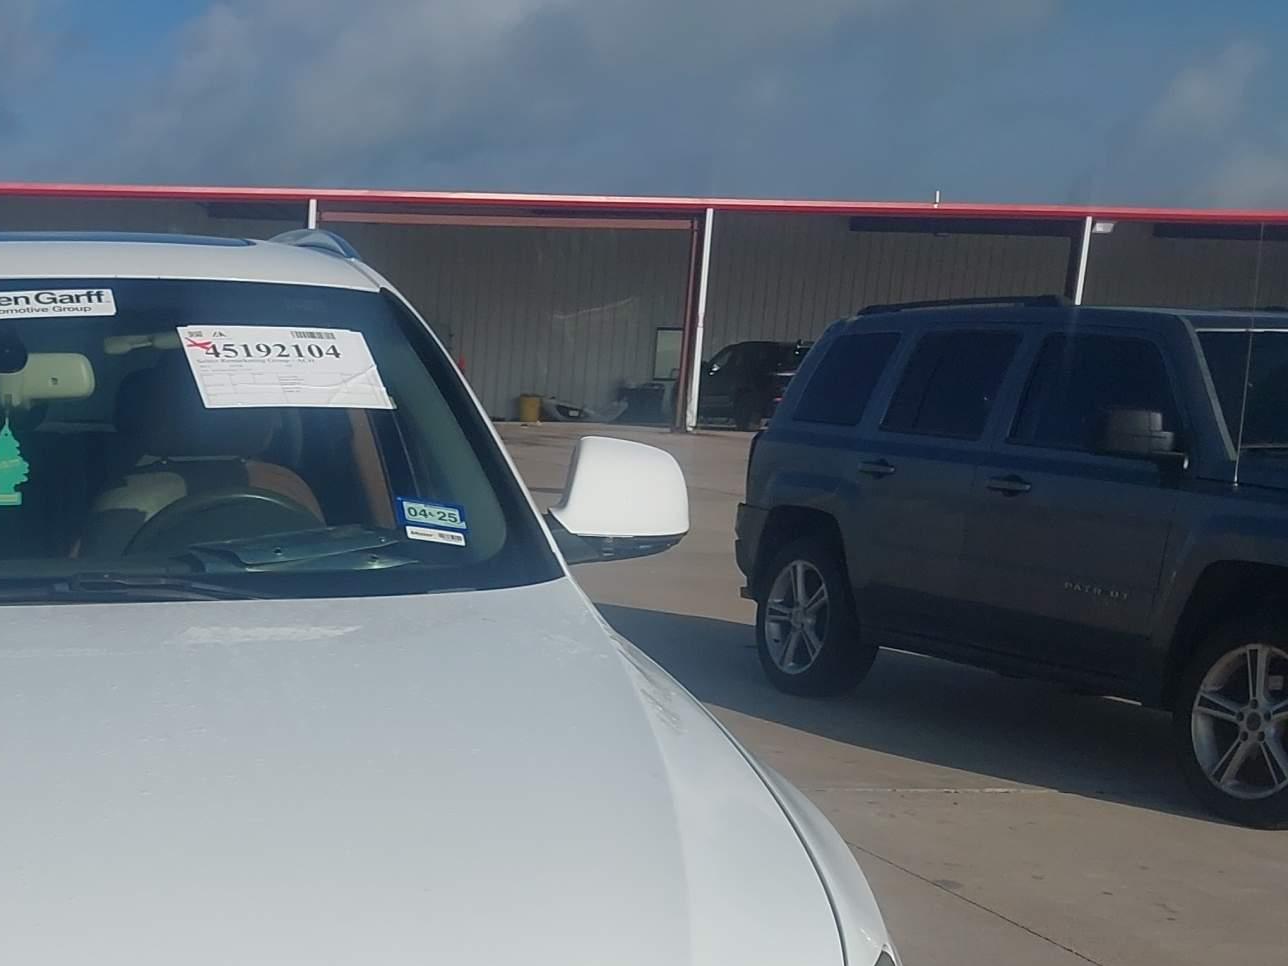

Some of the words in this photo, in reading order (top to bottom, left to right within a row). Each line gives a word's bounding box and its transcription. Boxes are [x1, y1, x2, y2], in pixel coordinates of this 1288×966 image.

[34, 291, 104, 305] Garff
[52, 305, 92, 314] Group
[205, 343, 341, 358] 45192104
